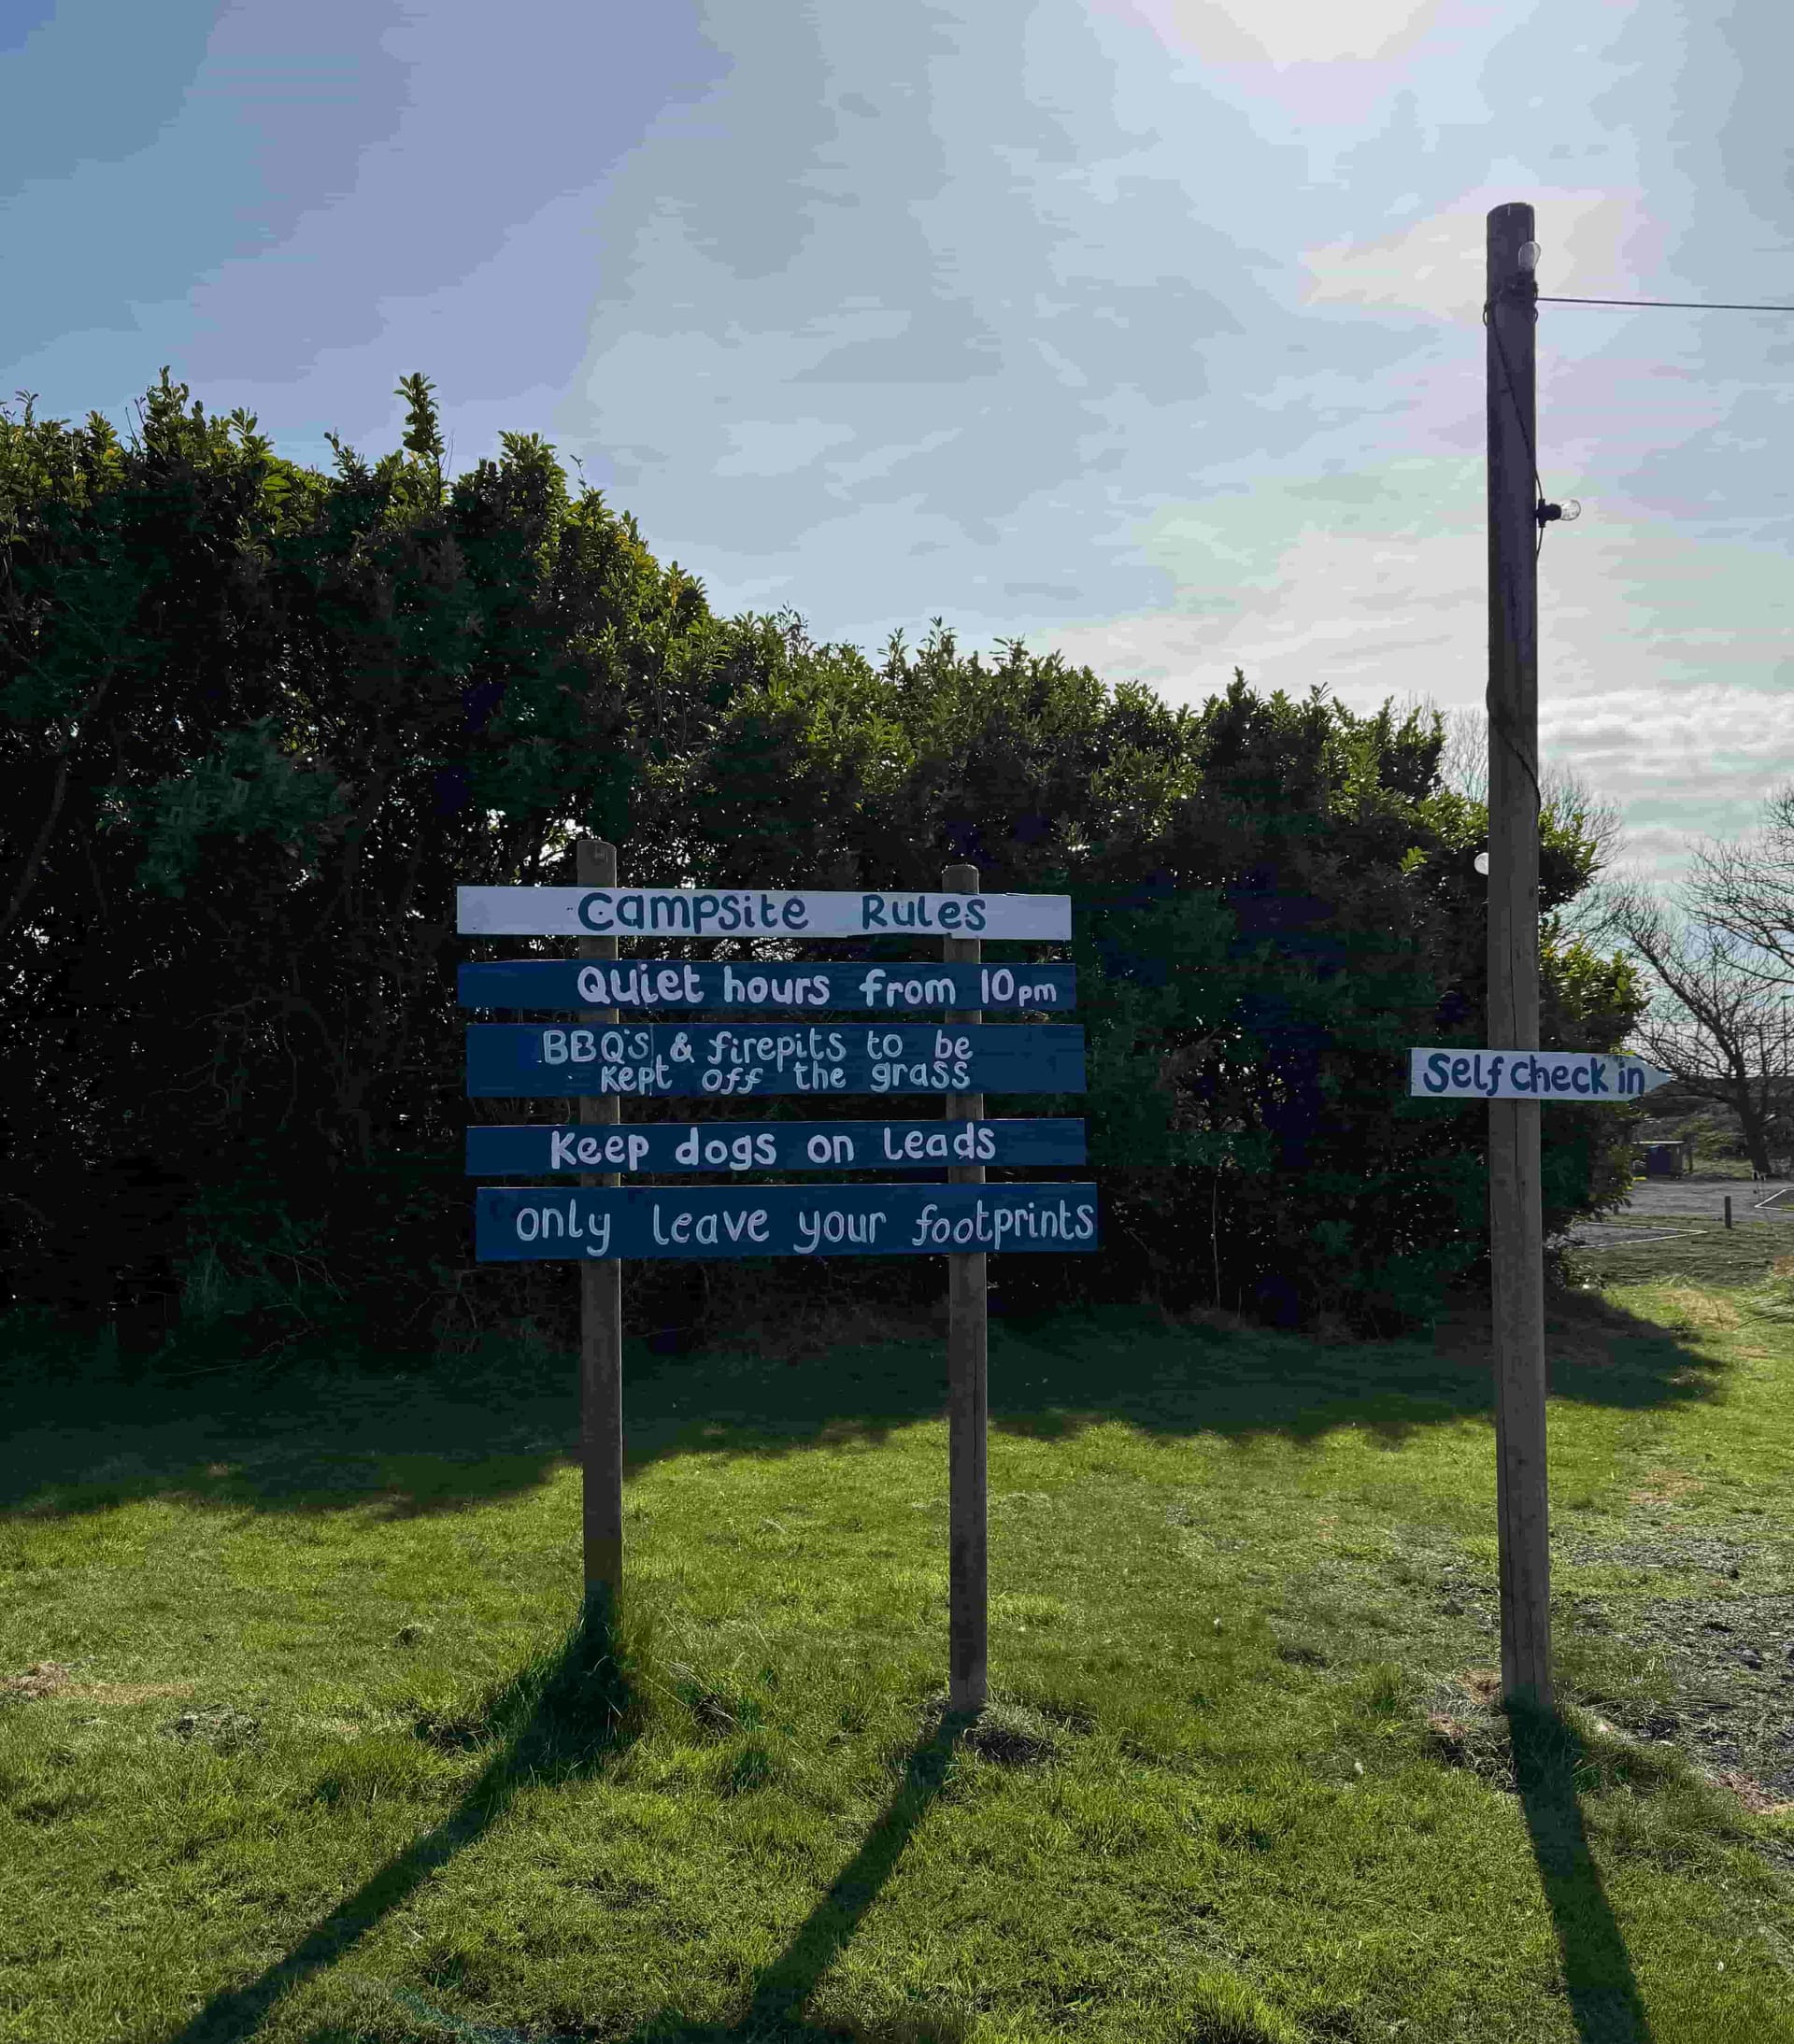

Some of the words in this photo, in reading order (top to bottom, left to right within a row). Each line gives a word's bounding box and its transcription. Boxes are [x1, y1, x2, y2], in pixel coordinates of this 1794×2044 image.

[577, 891, 809, 934] Campsite
[861, 894, 987, 931] Rules
[577, 963, 705, 1006] Quiet
[723, 964, 831, 1006] hours
[859, 968, 956, 1007] from
[542, 1029, 650, 1065] BBQ's
[670, 1031, 695, 1064] &
[707, 1027, 847, 1072] firepits
[866, 1029, 904, 1060] to
[934, 1029, 974, 1059] be
[702, 1068, 763, 1095] off
[793, 1060, 847, 1091] the
[870, 1060, 971, 1093] grass
[1423, 1053, 1504, 1096] Self
[1510, 1054, 1609, 1095] check
[1617, 1058, 1645, 1094] in
[550, 1130, 649, 1171] Keep
[675, 1127, 777, 1171] dogs
[806, 1134, 855, 1164] on
[652, 1204, 770, 1245] leave
[793, 1211, 887, 1255] your
[912, 1199, 1095, 1250] footprints
